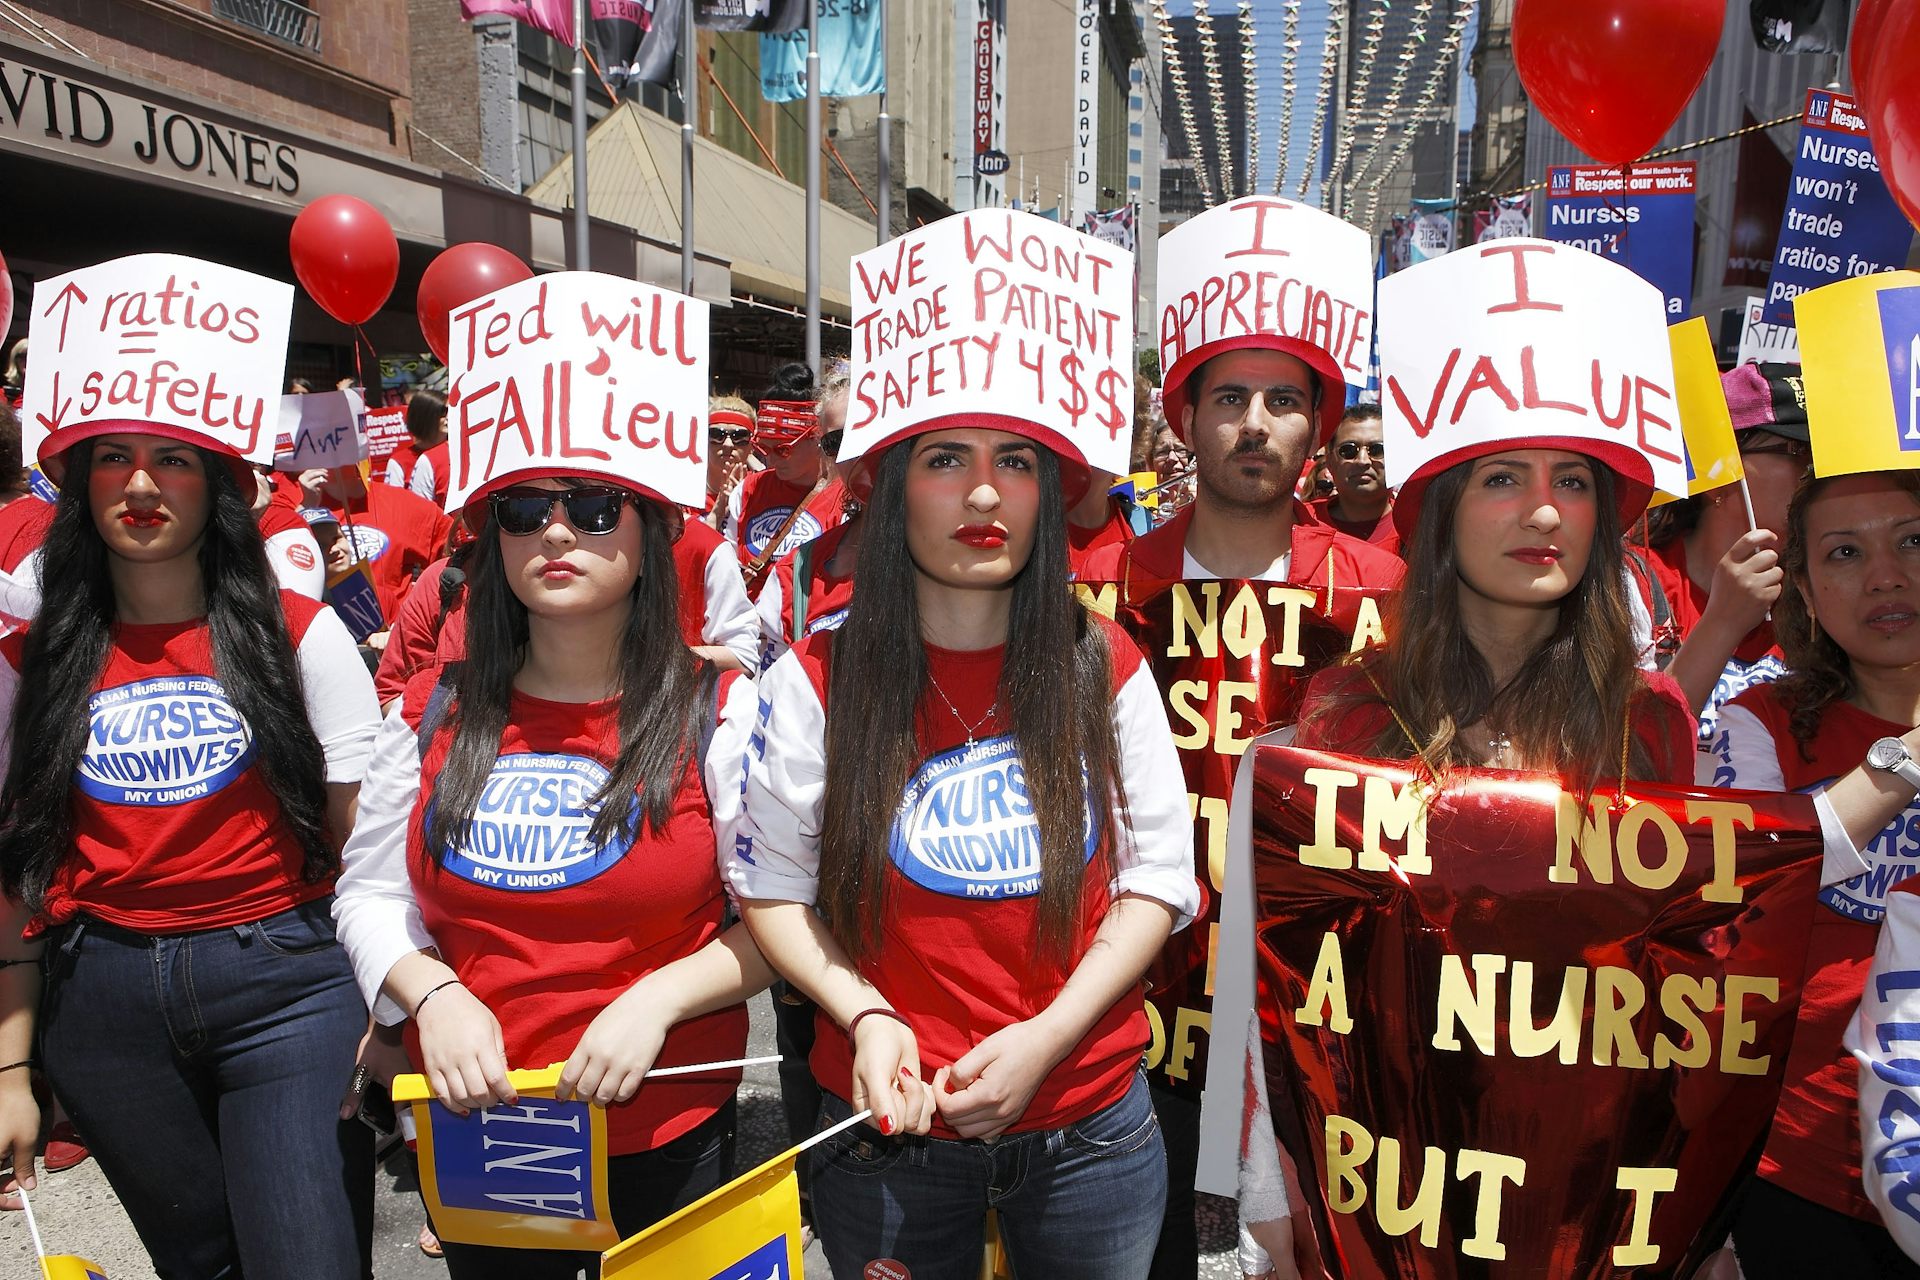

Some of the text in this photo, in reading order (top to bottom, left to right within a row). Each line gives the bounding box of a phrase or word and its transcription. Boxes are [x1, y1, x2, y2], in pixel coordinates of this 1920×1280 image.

[1078, 0, 1094, 83] ROGER
[977, 24, 992, 143] CAUSEWAY
[1809, 99, 1829, 118] ANF
[0, 61, 299, 197] VID JONES
[1079, 99, 1090, 185] DAVID
[1830, 107, 1867, 131] Respe
[1552, 174, 1571, 188] ANF
[1575, 173, 1693, 193] Respect our work.
[1794, 174, 1859, 205] won't
[1224, 200, 1294, 259] I
[1552, 204, 1641, 226] Nurses
[1787, 206, 1844, 239] trade
[856, 214, 1113, 304] WE WON'T
[1480, 245, 1563, 314] I
[1727, 257, 1772, 273] MYE
[1778, 245, 1879, 277] ratios for
[99, 275, 260, 343] ratios
[454, 281, 697, 371] Ted will
[853, 267, 1120, 363] TRADE PATIENT
[1160, 270, 1369, 374] APPRECIATE
[80, 360, 264, 454] safety
[851, 332, 1127, 441] SAFETY 4 $$
[1387, 345, 1683, 464] VALUE
[1167, 582, 1317, 667] NOT
[1349, 597, 1388, 654] A
[131, 681, 186, 697] NURSING
[188, 680, 229, 698] FEDER
[89, 700, 242, 747] NURSES
[82, 738, 243, 782] MIDWIVES
[513, 757, 567, 770] NURSING
[568, 760, 608, 784] FEDER
[124, 782, 208, 803] MY UNION
[476, 775, 604, 819] URSES
[920, 764, 1036, 831] NURS
[1299, 767, 1432, 876] IM
[1548, 790, 1755, 904] NOT
[473, 866, 567, 888] MY UNION
[966, 879, 1042, 896] MY UNI
[1830, 893, 1859, 915] MY
[1295, 930, 1779, 1076] A NURSE
[1325, 1114, 1679, 1267] BUT I
